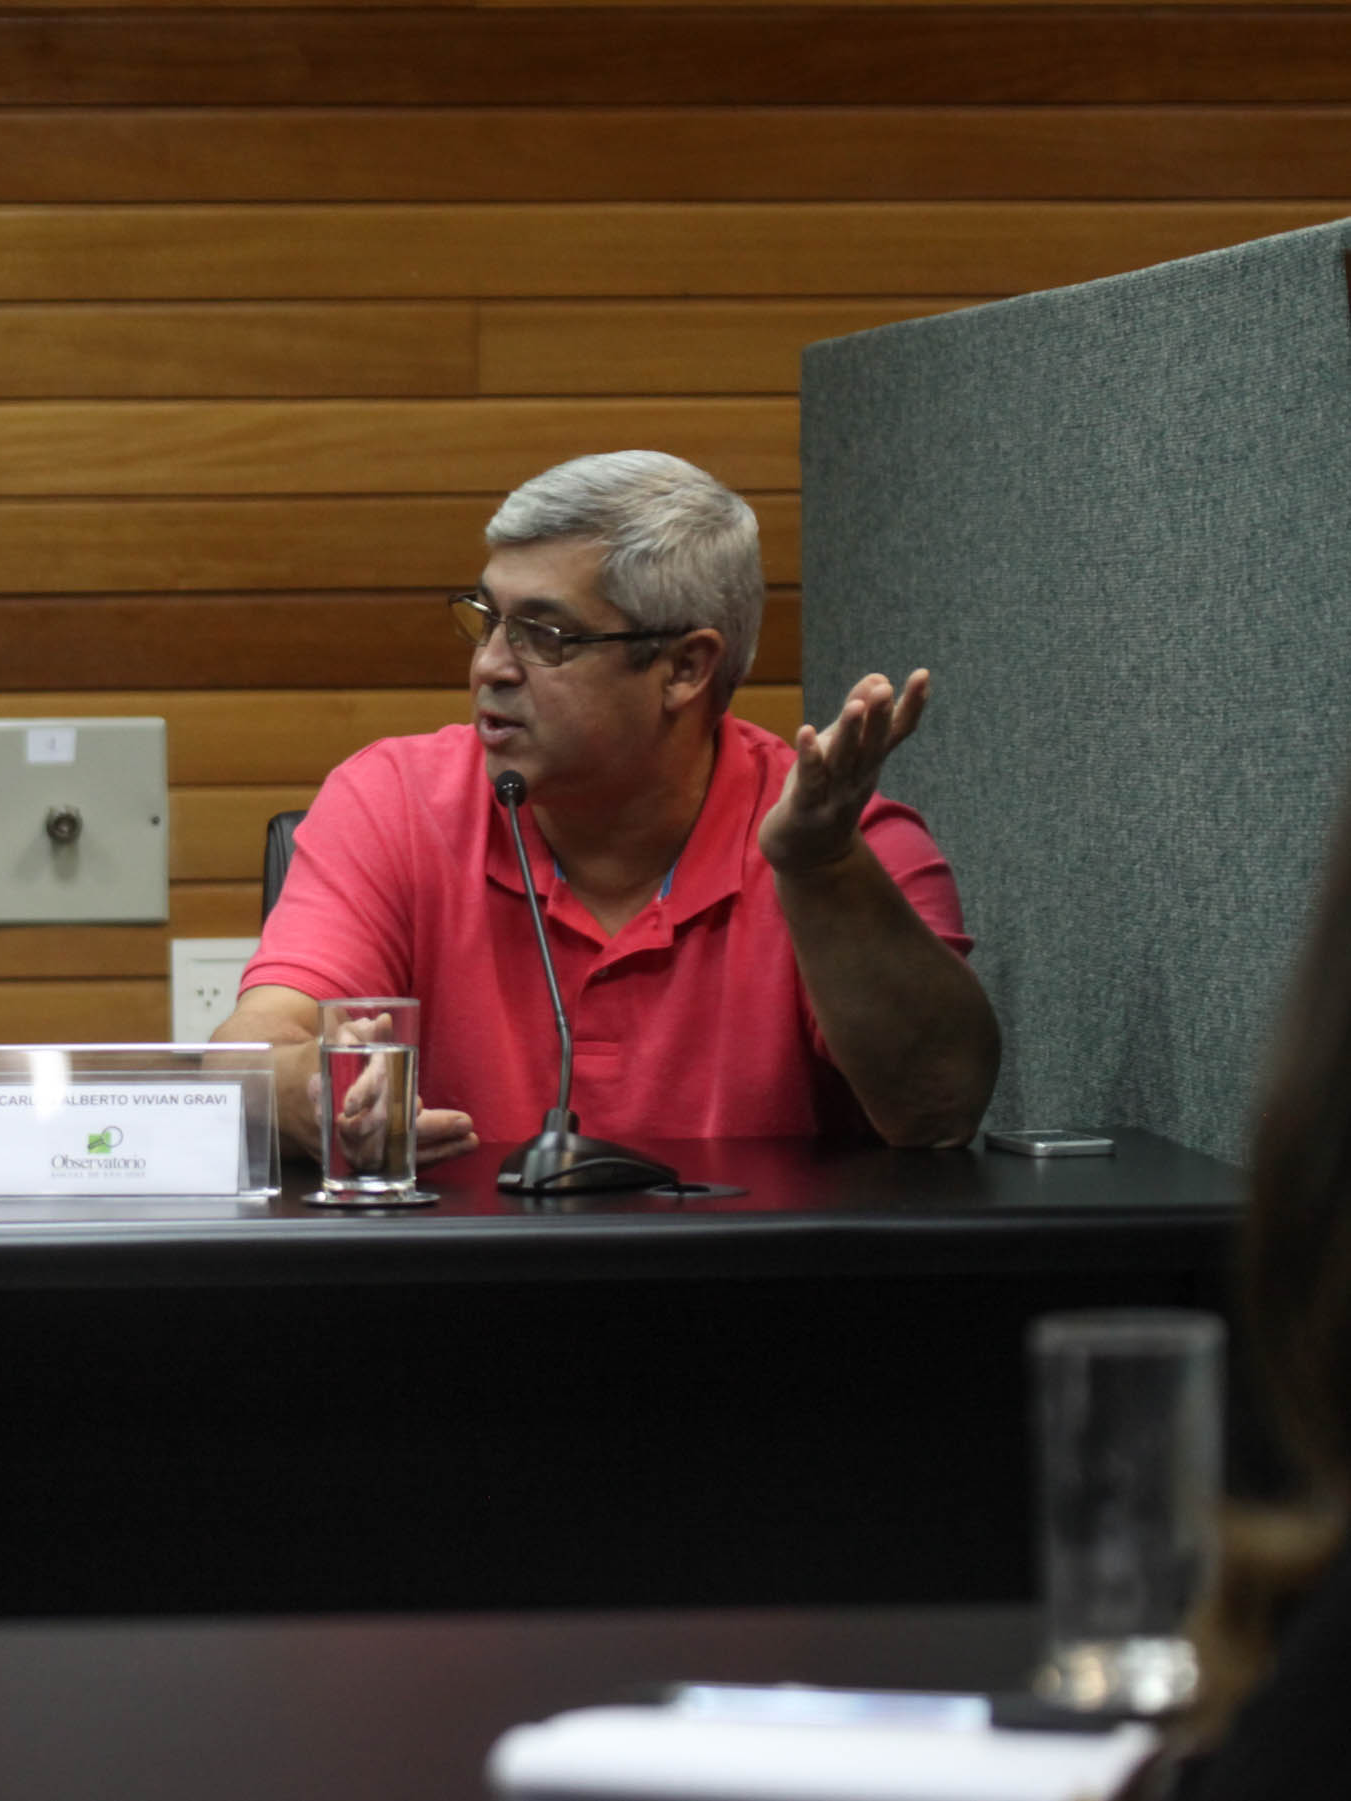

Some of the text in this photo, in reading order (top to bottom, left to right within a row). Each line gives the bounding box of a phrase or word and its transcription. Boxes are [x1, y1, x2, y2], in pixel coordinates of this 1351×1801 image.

[62, 1094, 129, 1106] ALBERTO
[133, 1093, 179, 1105] VIVIAN
[183, 1093, 227, 1105] GRAVI
